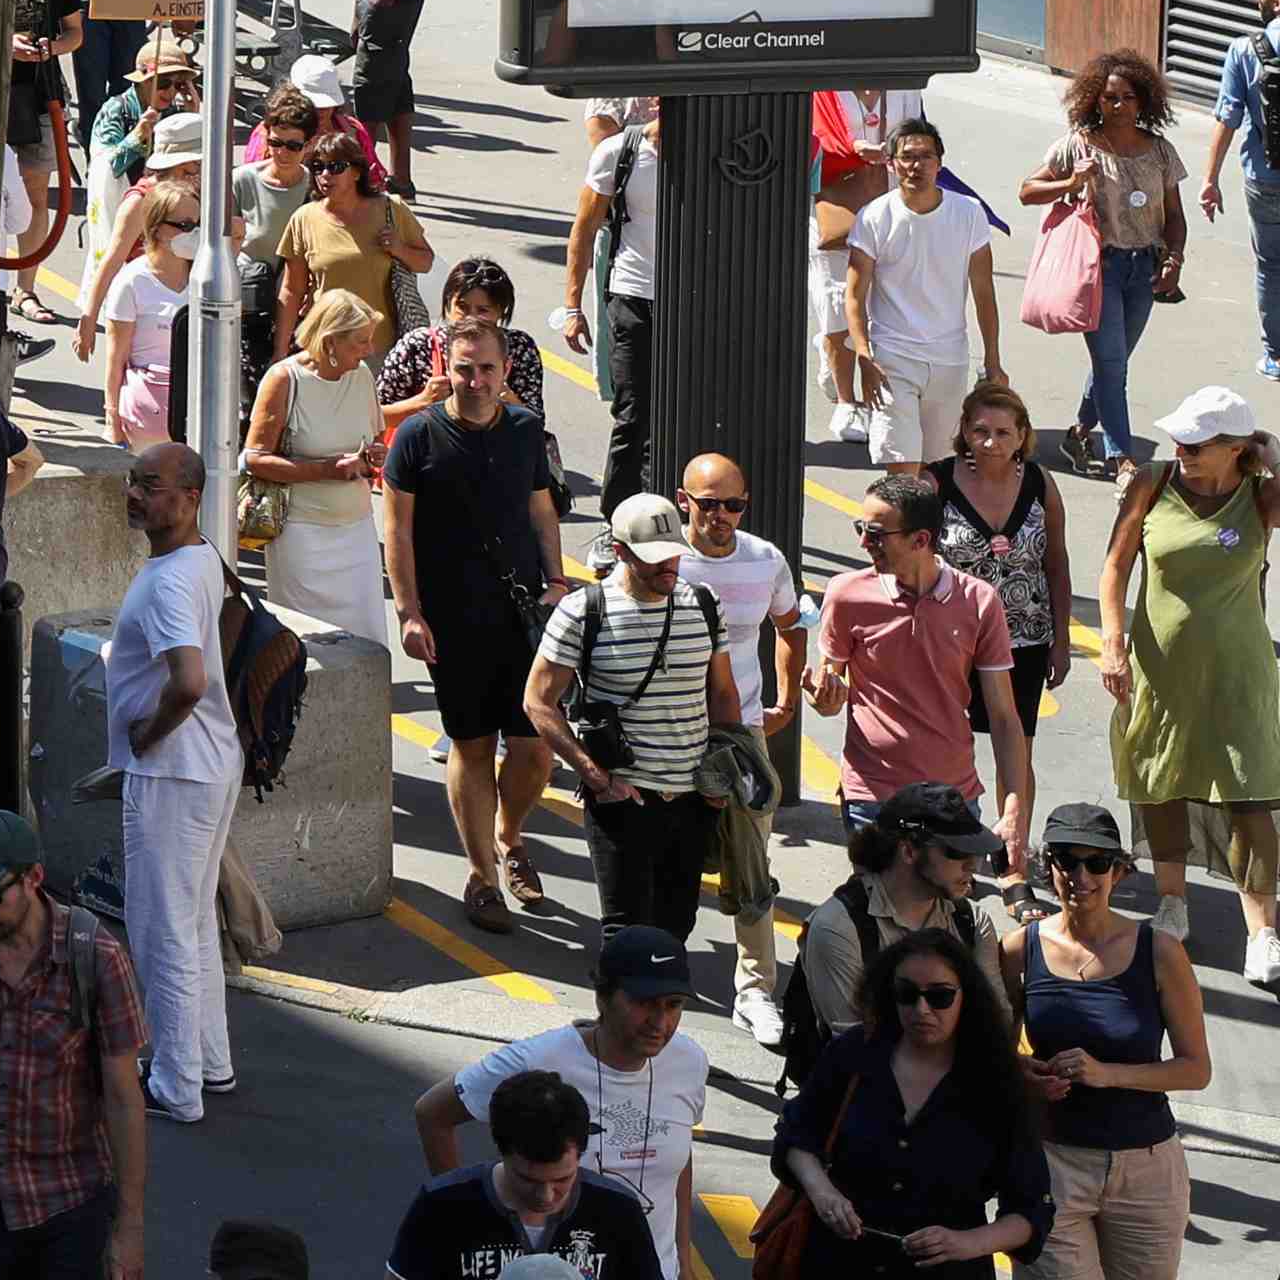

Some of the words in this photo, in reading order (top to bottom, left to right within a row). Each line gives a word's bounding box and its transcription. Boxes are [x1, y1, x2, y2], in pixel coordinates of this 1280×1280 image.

[169, 0, 206, 17] EINSTE
[704, 32, 751, 49] Clear
[753, 30, 825, 49] Channel
